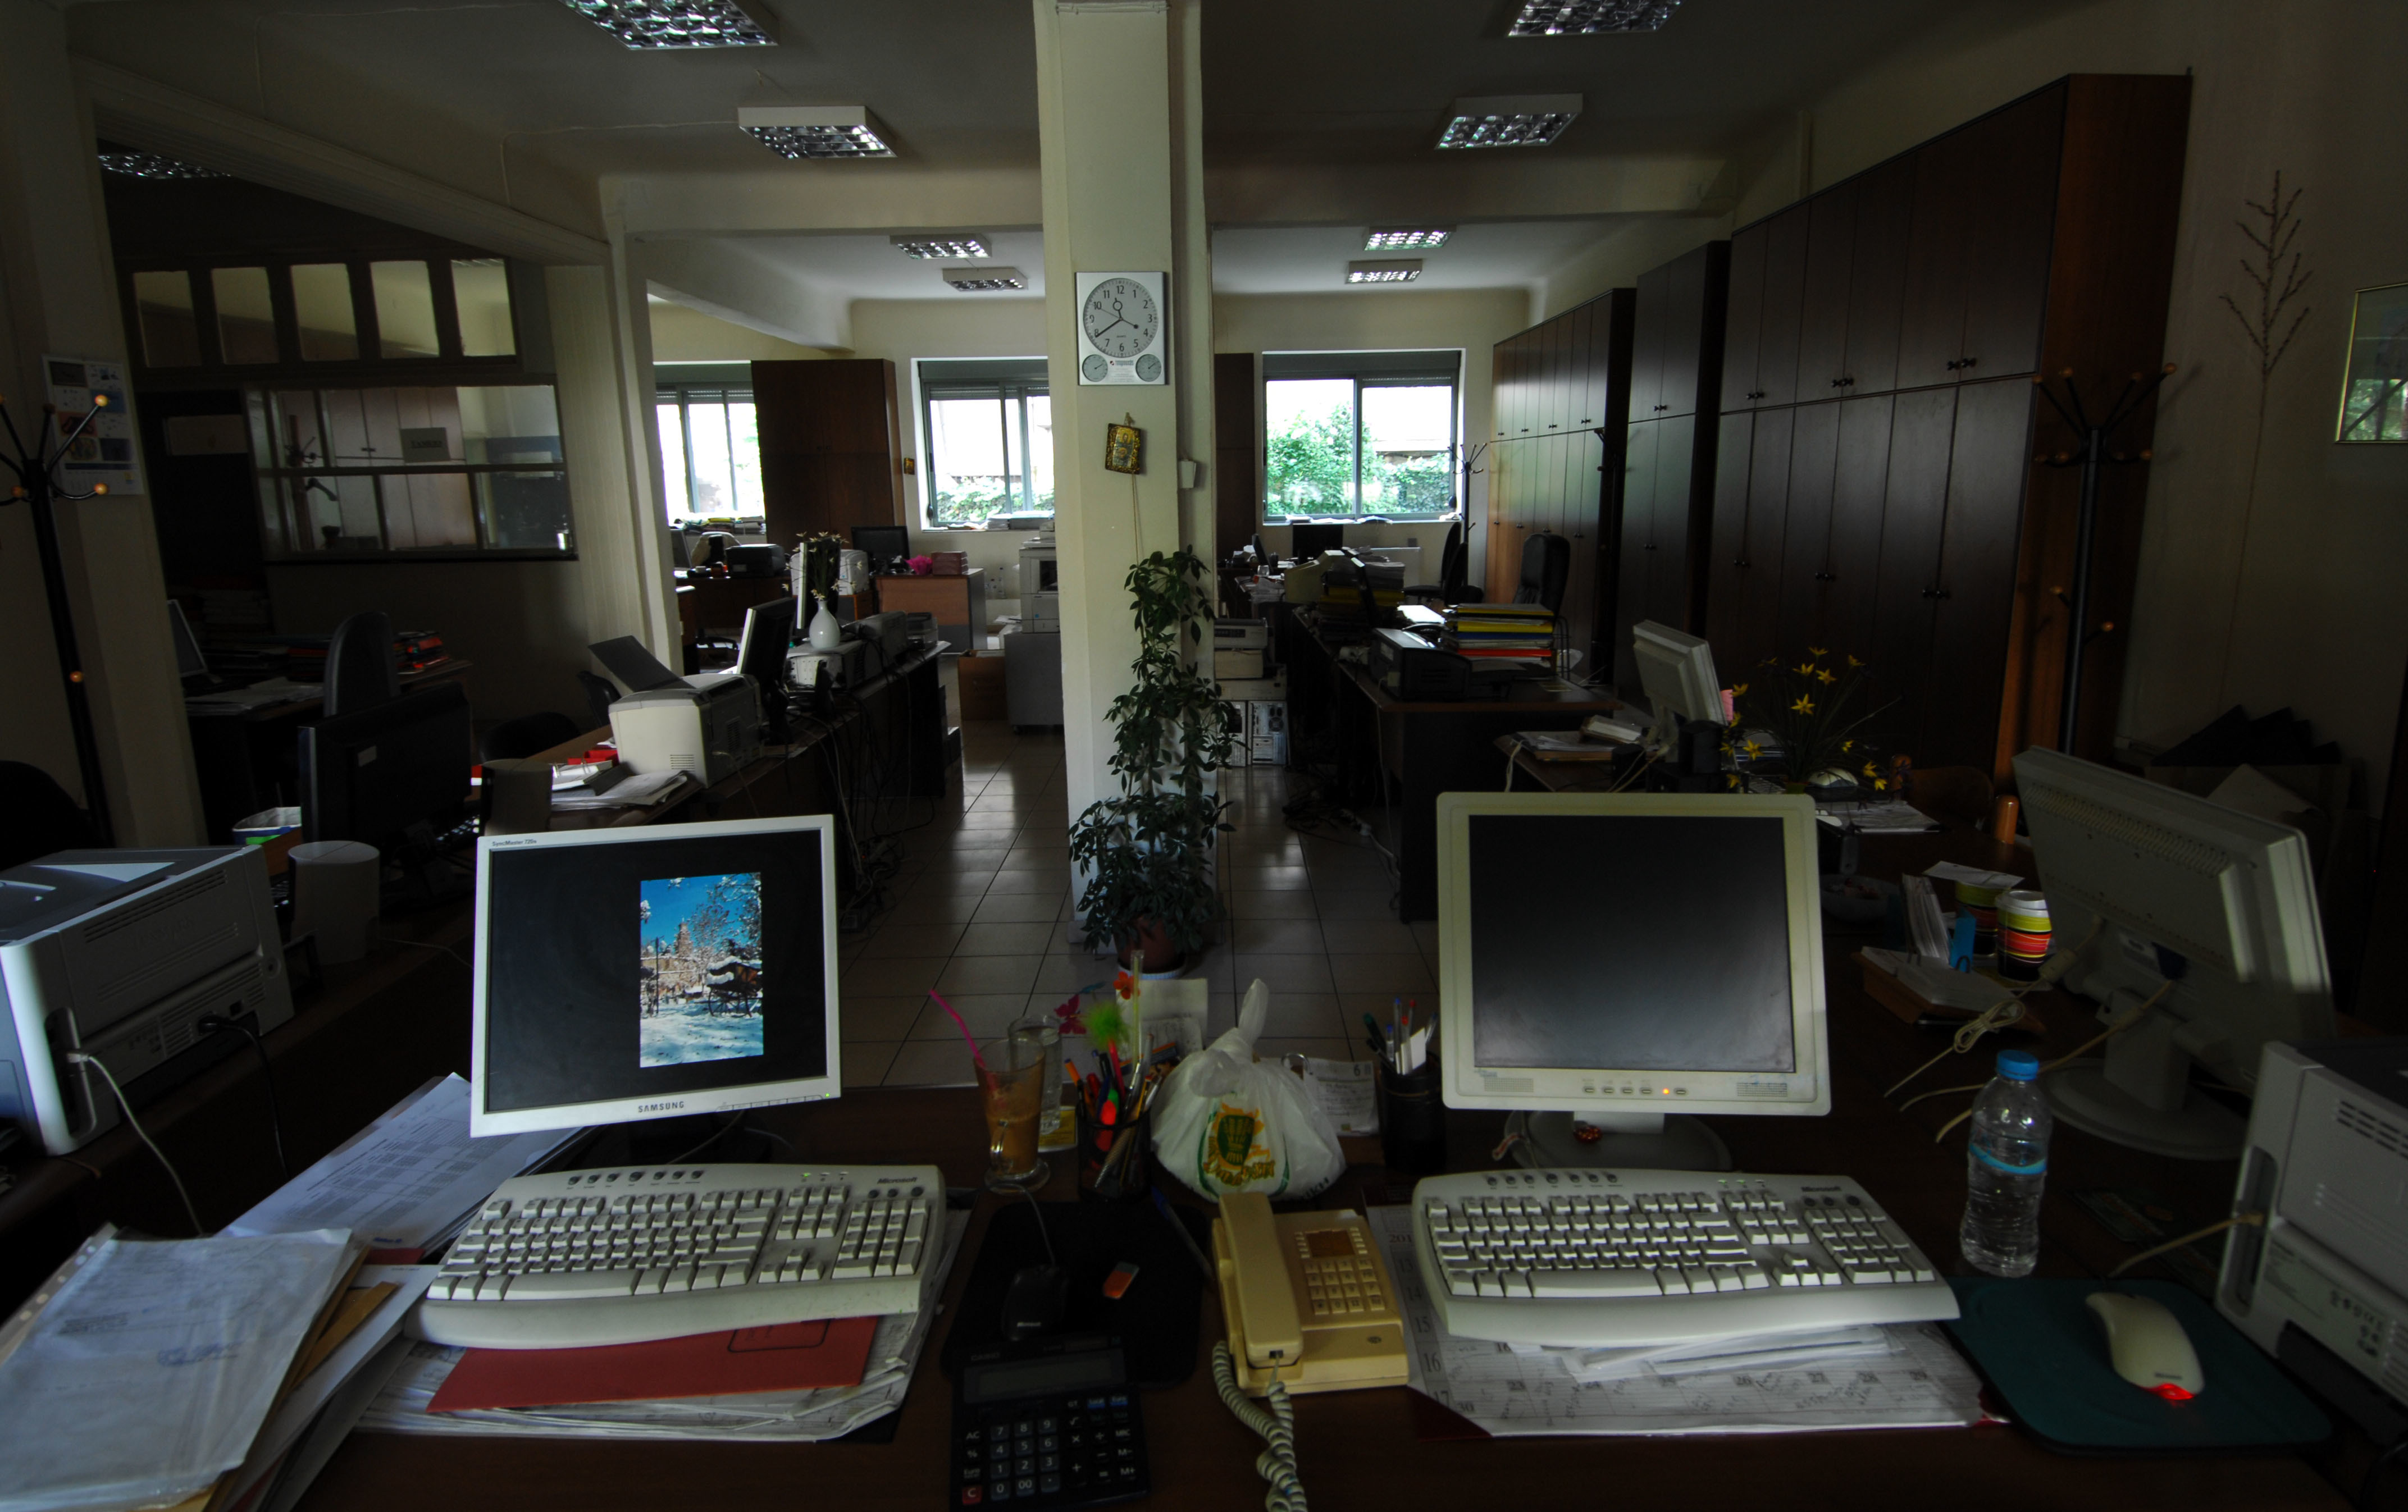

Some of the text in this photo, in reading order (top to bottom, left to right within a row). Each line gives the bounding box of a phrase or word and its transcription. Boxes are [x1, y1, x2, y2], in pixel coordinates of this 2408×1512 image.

[1103, 290, 1110, 298] 11
[1117, 285, 1124, 294] 12
[1133, 290, 1137, 298] 1
[1094, 302, 1102, 310] 10
[1089, 314, 1094, 323] 9
[1094, 328, 1099, 337] 8
[1105, 339, 1110, 347] 7
[1119, 343, 1124, 351] 6
[1133, 339, 1138, 348] 5
[1354, 1064, 1361, 1076] 6
[638, 1101, 685, 1113] SAMSUNG
[1398, 1257, 1414, 1274] 13
[1406, 1287, 1422, 1303] 14
[1415, 1316, 1431, 1333] 15
[1496, 1342, 1511, 1353] 16
[1424, 1354, 1441, 1372] 16
[1735, 1376, 1752, 1387] 26
[1809, 1373, 1825, 1383] 27
[1862, 1372, 1878, 1383] 28
[1508, 1381, 1525, 1391] 23
[1434, 1390, 1450, 1408] 17
[1457, 1401, 1475, 1412] 30
[1020, 1423, 1028, 1432] 8
[1043, 1419, 1051, 1429] 9
[966, 1431, 980, 1440] AC
[997, 1426, 1004, 1436] 7
[1021, 1441, 1028, 1450] 5
[1045, 1438, 1052, 1447] 6
[996, 1445, 1004, 1454] 4
[1021, 1460, 1029, 1469] 2
[1046, 1457, 1053, 1467] 3
[998, 1464, 1002, 1473] 1
[996, 1483, 1005, 1493] 0
[1018, 1479, 1033, 1490] 00
[967, 1487, 977, 1498] C
